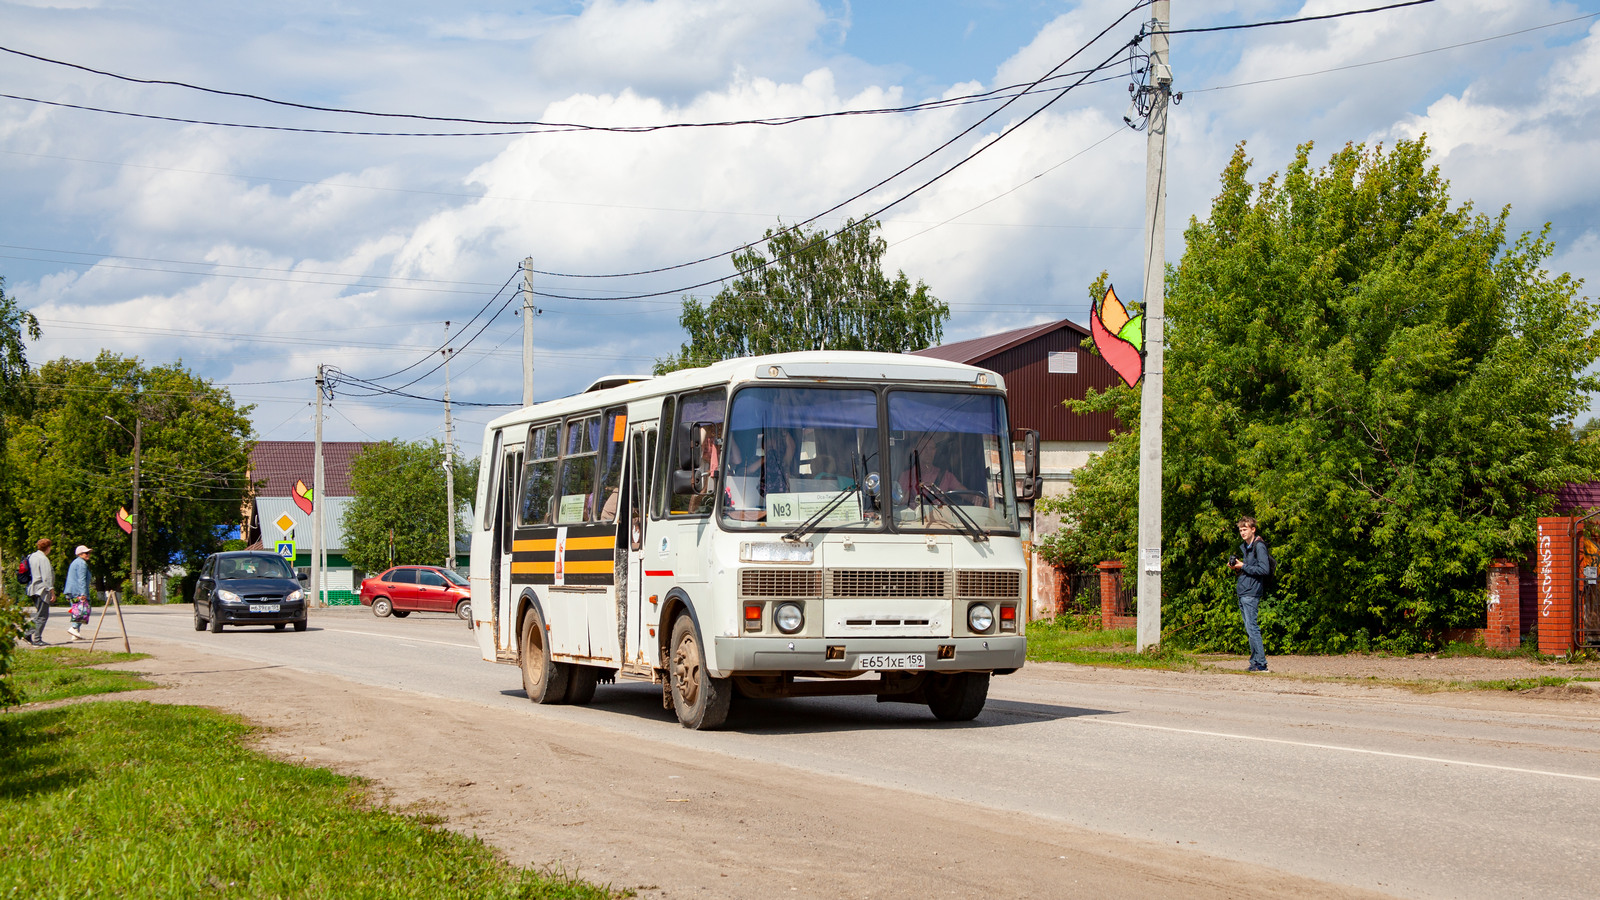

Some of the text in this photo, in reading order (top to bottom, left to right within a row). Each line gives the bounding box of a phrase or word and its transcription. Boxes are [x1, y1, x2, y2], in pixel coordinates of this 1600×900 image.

[773, 503, 792, 517] №3
[862, 655, 923, 668] Е651ХЕ 159
